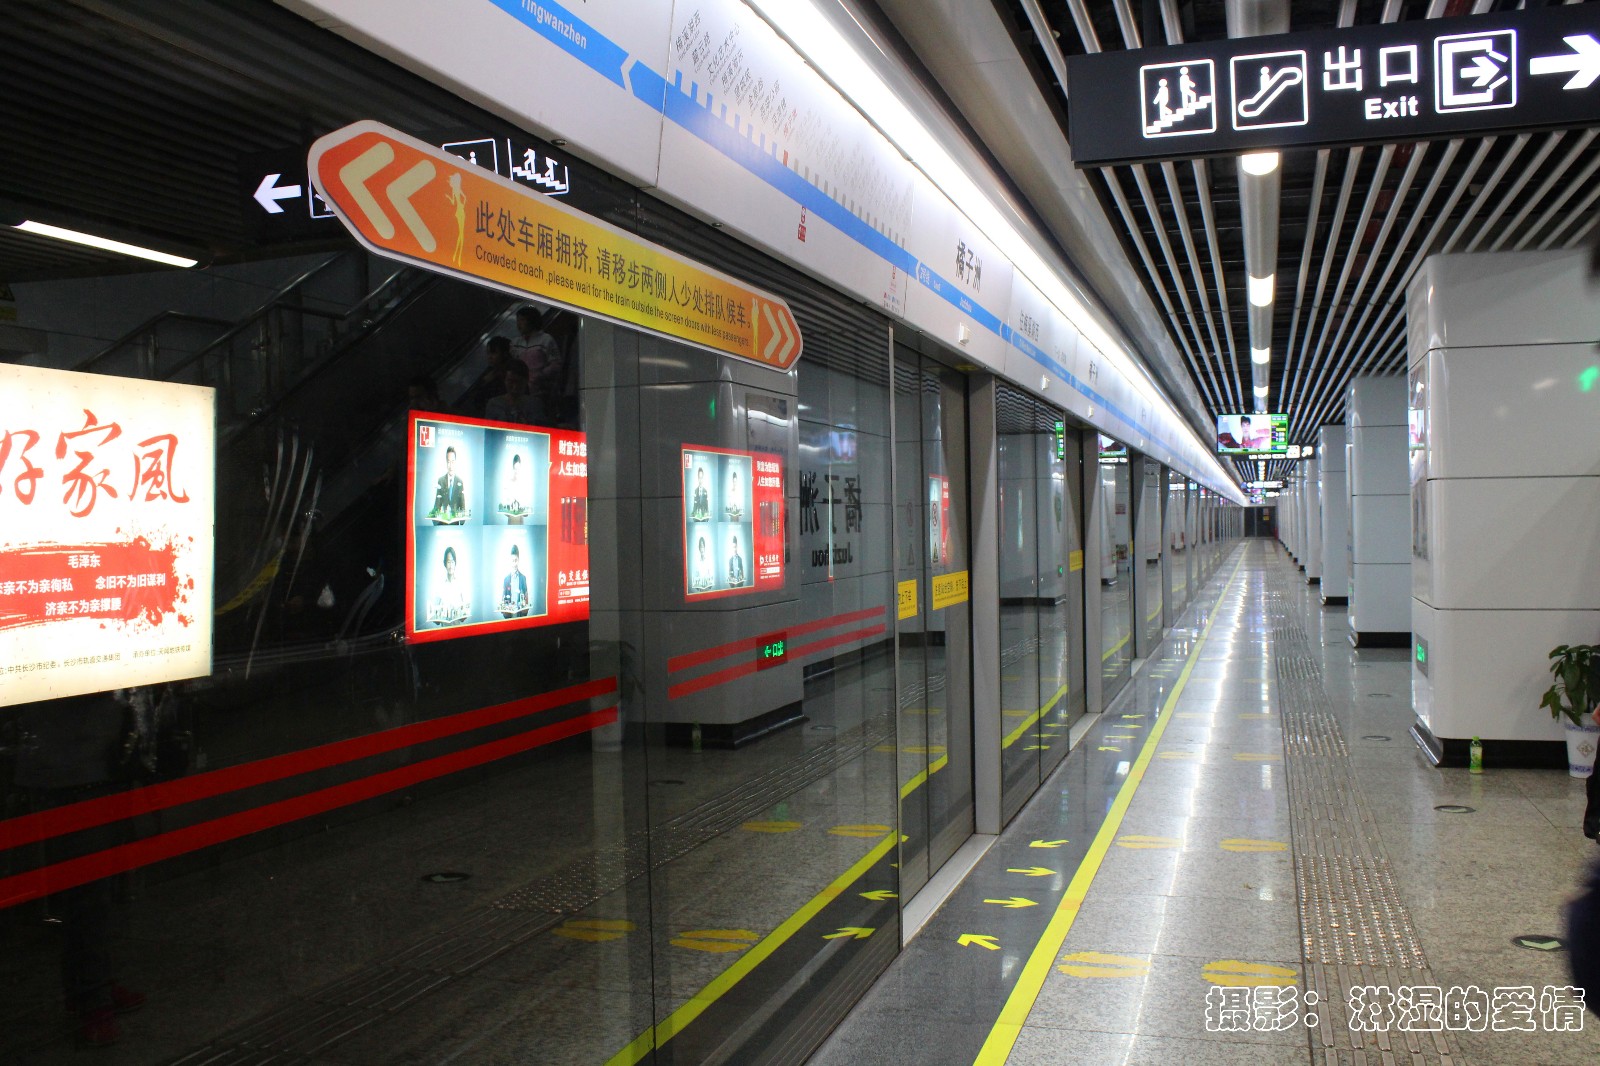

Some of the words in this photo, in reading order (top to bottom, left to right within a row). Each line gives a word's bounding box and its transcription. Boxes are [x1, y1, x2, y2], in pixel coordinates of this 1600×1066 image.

[1323, 44, 1418, 91] 出口
[1364, 96, 1419, 121] Exit
[475, 245, 517, 271] Crowded
[518, 262, 545, 280] coach
[576, 281, 591, 296] wait
[592, 284, 602, 298] for
[603, 287, 614, 302] the
[615, 292, 631, 308] train
[632, 299, 654, 316] outside
[664, 312, 684, 325] screen
[68, 554, 101, 569] 毛泽东
[95, 573, 166, 590] 念旧不为旧谋利
[45, 597, 122, 616] 济亲不为亲撑腰
